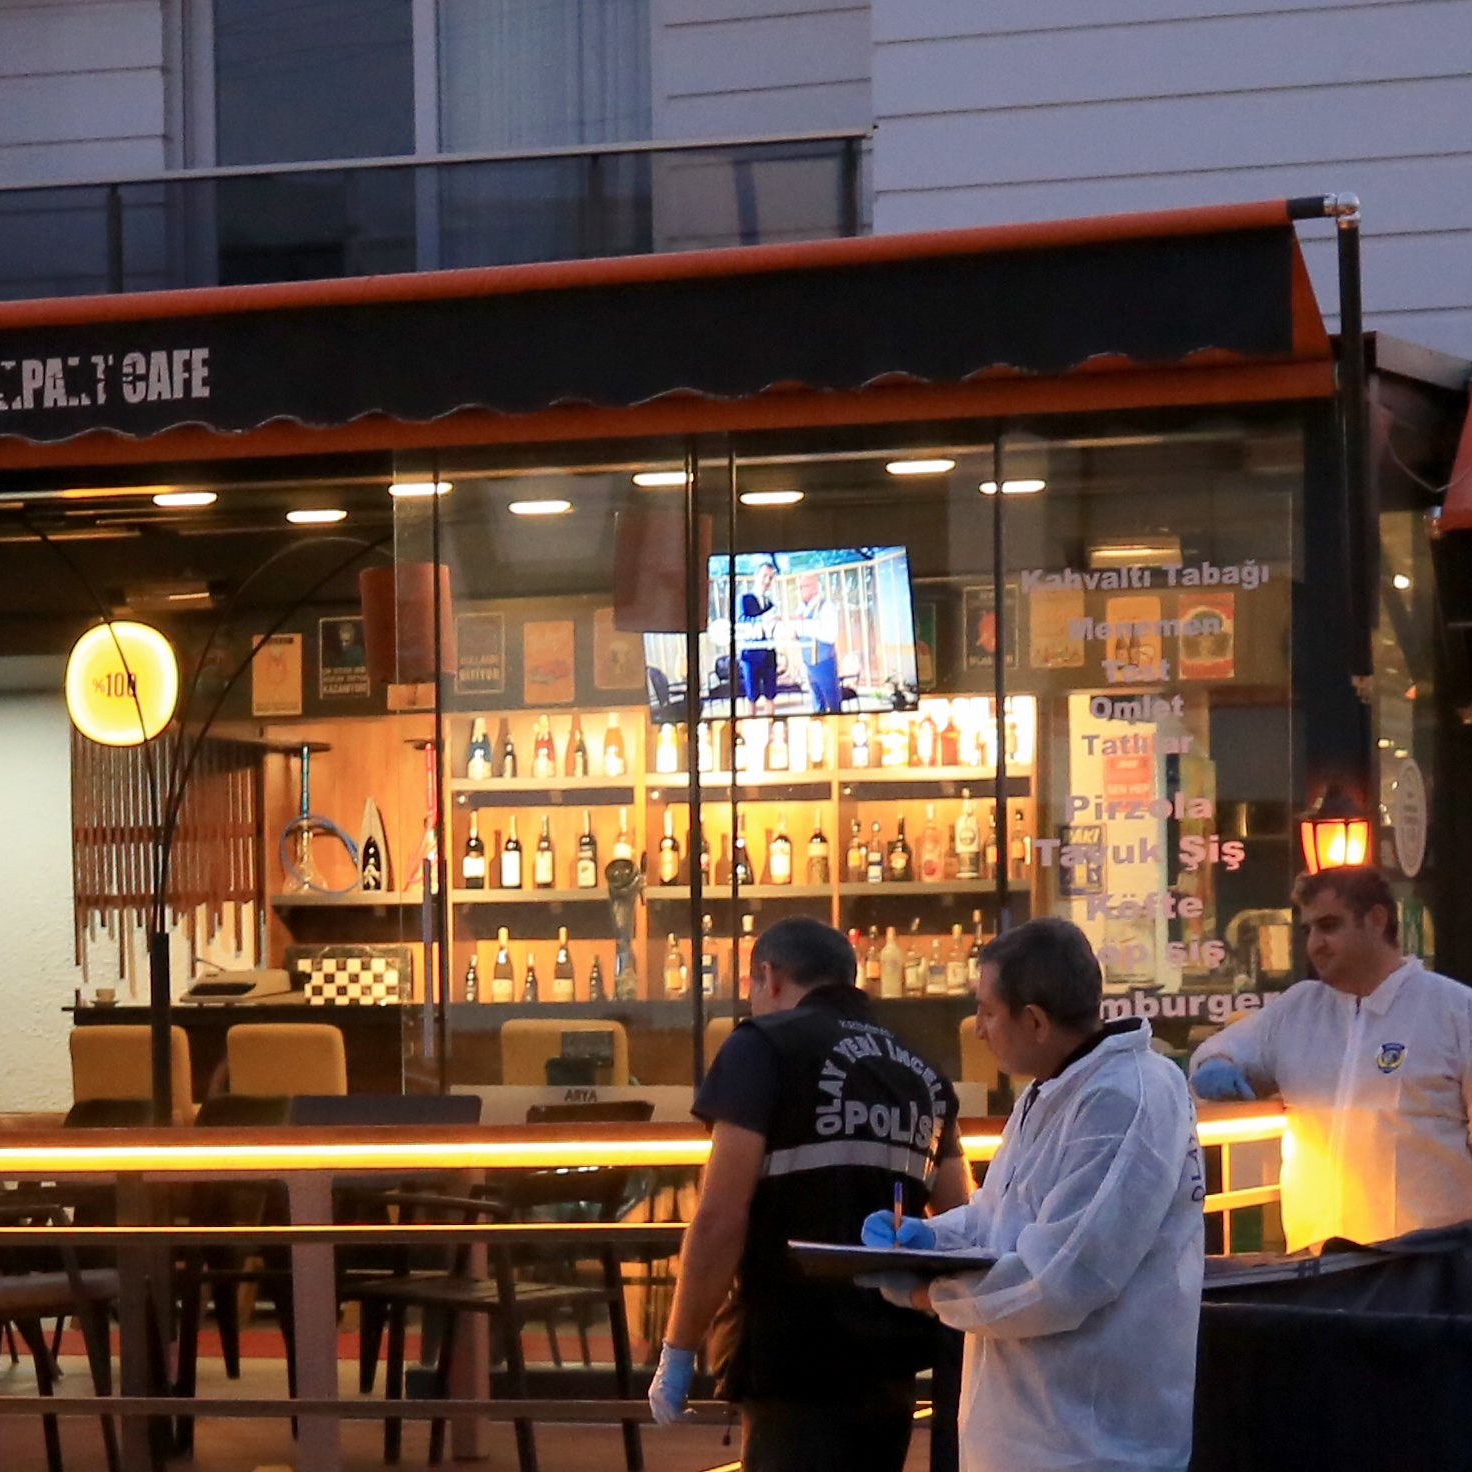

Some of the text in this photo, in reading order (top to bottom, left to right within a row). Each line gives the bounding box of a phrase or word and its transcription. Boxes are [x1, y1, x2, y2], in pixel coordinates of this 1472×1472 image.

[122, 347, 210, 405] CAFE
[1020, 559, 1270, 593] Kahvaltı Tabağı
[1069, 617, 1221, 641] Menemen
[1101, 660, 1171, 683] Tost
[1090, 694, 1185, 719] Omlet
[1082, 733, 1195, 756] Tatlılar
[1064, 791, 1214, 822] Pirzola
[1032, 834, 1247, 871] Tavuk Şiş
[1087, 891, 1205, 920] Köfte
[815, 1058, 847, 1136] OLAY
